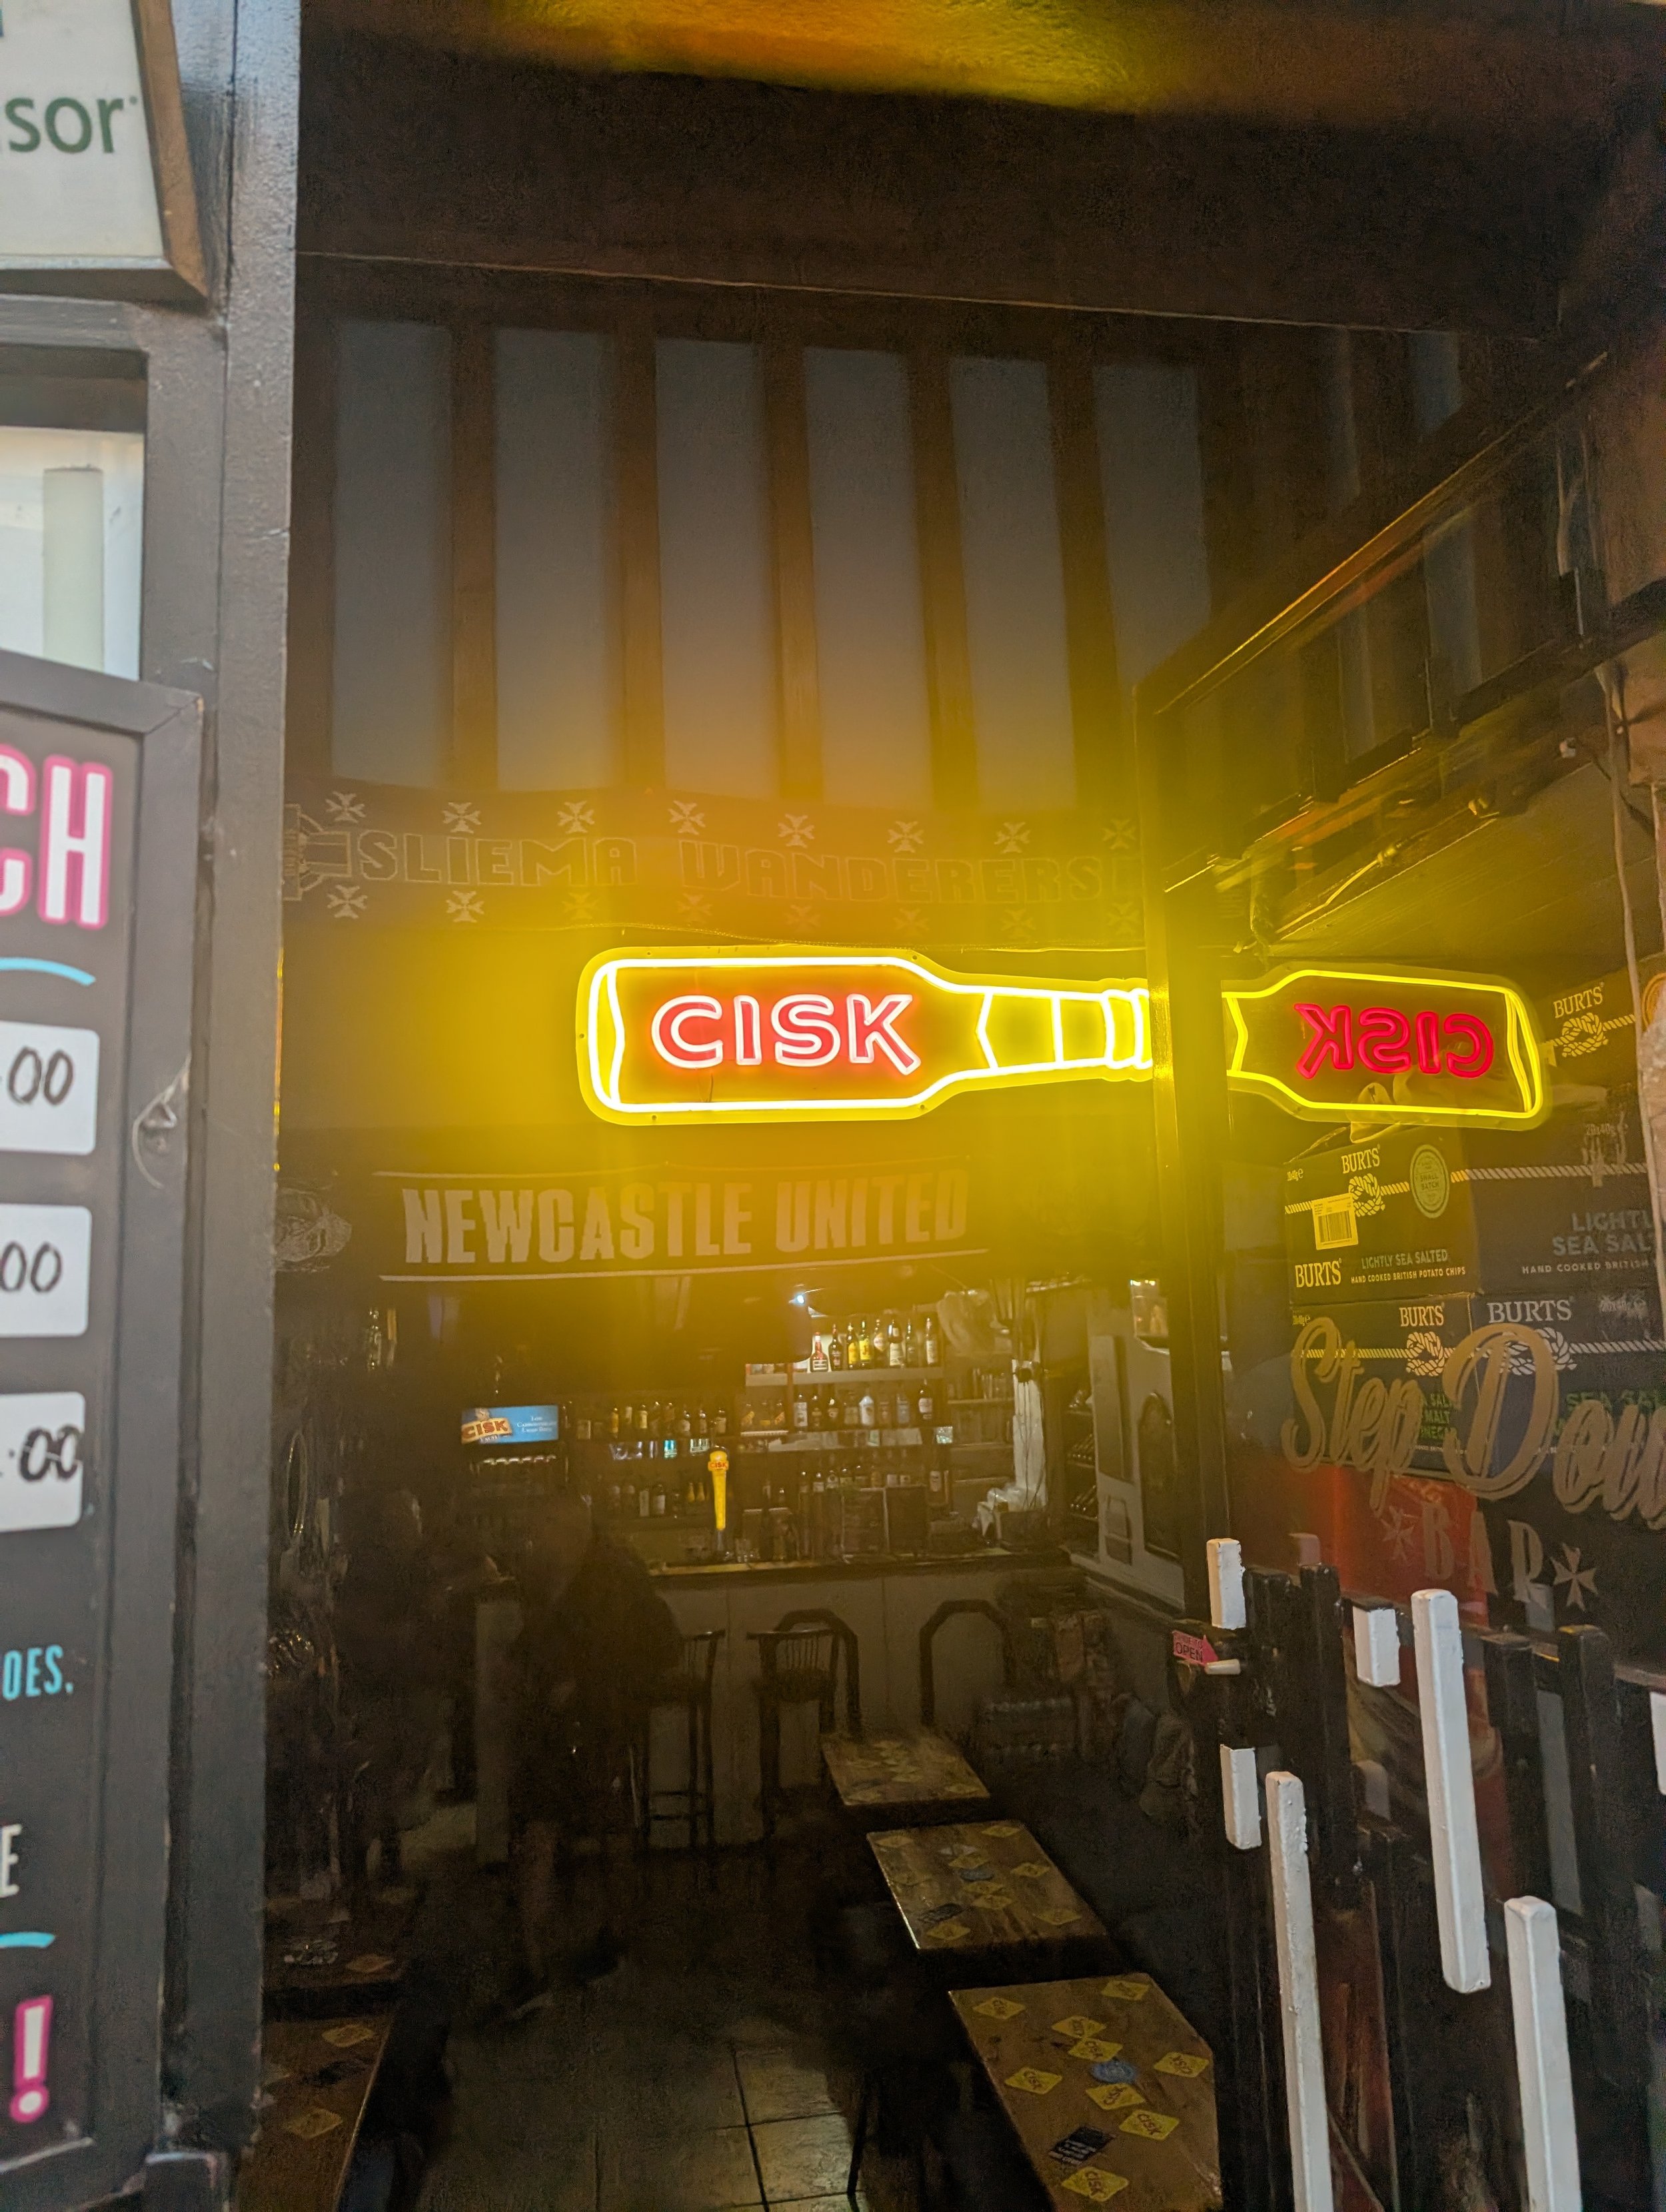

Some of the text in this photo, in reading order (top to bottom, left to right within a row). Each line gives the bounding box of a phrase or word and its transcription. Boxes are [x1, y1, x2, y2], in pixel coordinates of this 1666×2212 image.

[357, 829, 638, 886] SLIEMA
[678, 838, 1103, 903] WANDERERS
[1553, 985, 1603, 1019] BURTS
[651, 993, 921, 1075] CISK
[1341, 1147, 1381, 1174] BURTS
[402, 1169, 969, 1264] NEWCASTLE UNITED
[1551, 1233, 1654, 1257] SEA SAL
[1361, 1249, 1449, 1270] LIGHTLY SEA SALTED
[1521, 1264, 1552, 1275] HAND
[1556, 1261, 1601, 1273] COOKED
[1295, 1260, 1342, 1288] BURTS
[1350, 1266, 1466, 1285] HAND COOKED BRITISH POTATO CHIPS
[1399, 1305, 1445, 1327] BURTS
[1487, 1299, 1572, 1324] BURTS
[462, 1420, 508, 1440] CISK
[1281, 1317, 1424, 1519] Step
[1421, 1501, 1547, 1611] BAR
[1175, 1641, 1204, 1663] OPEN
